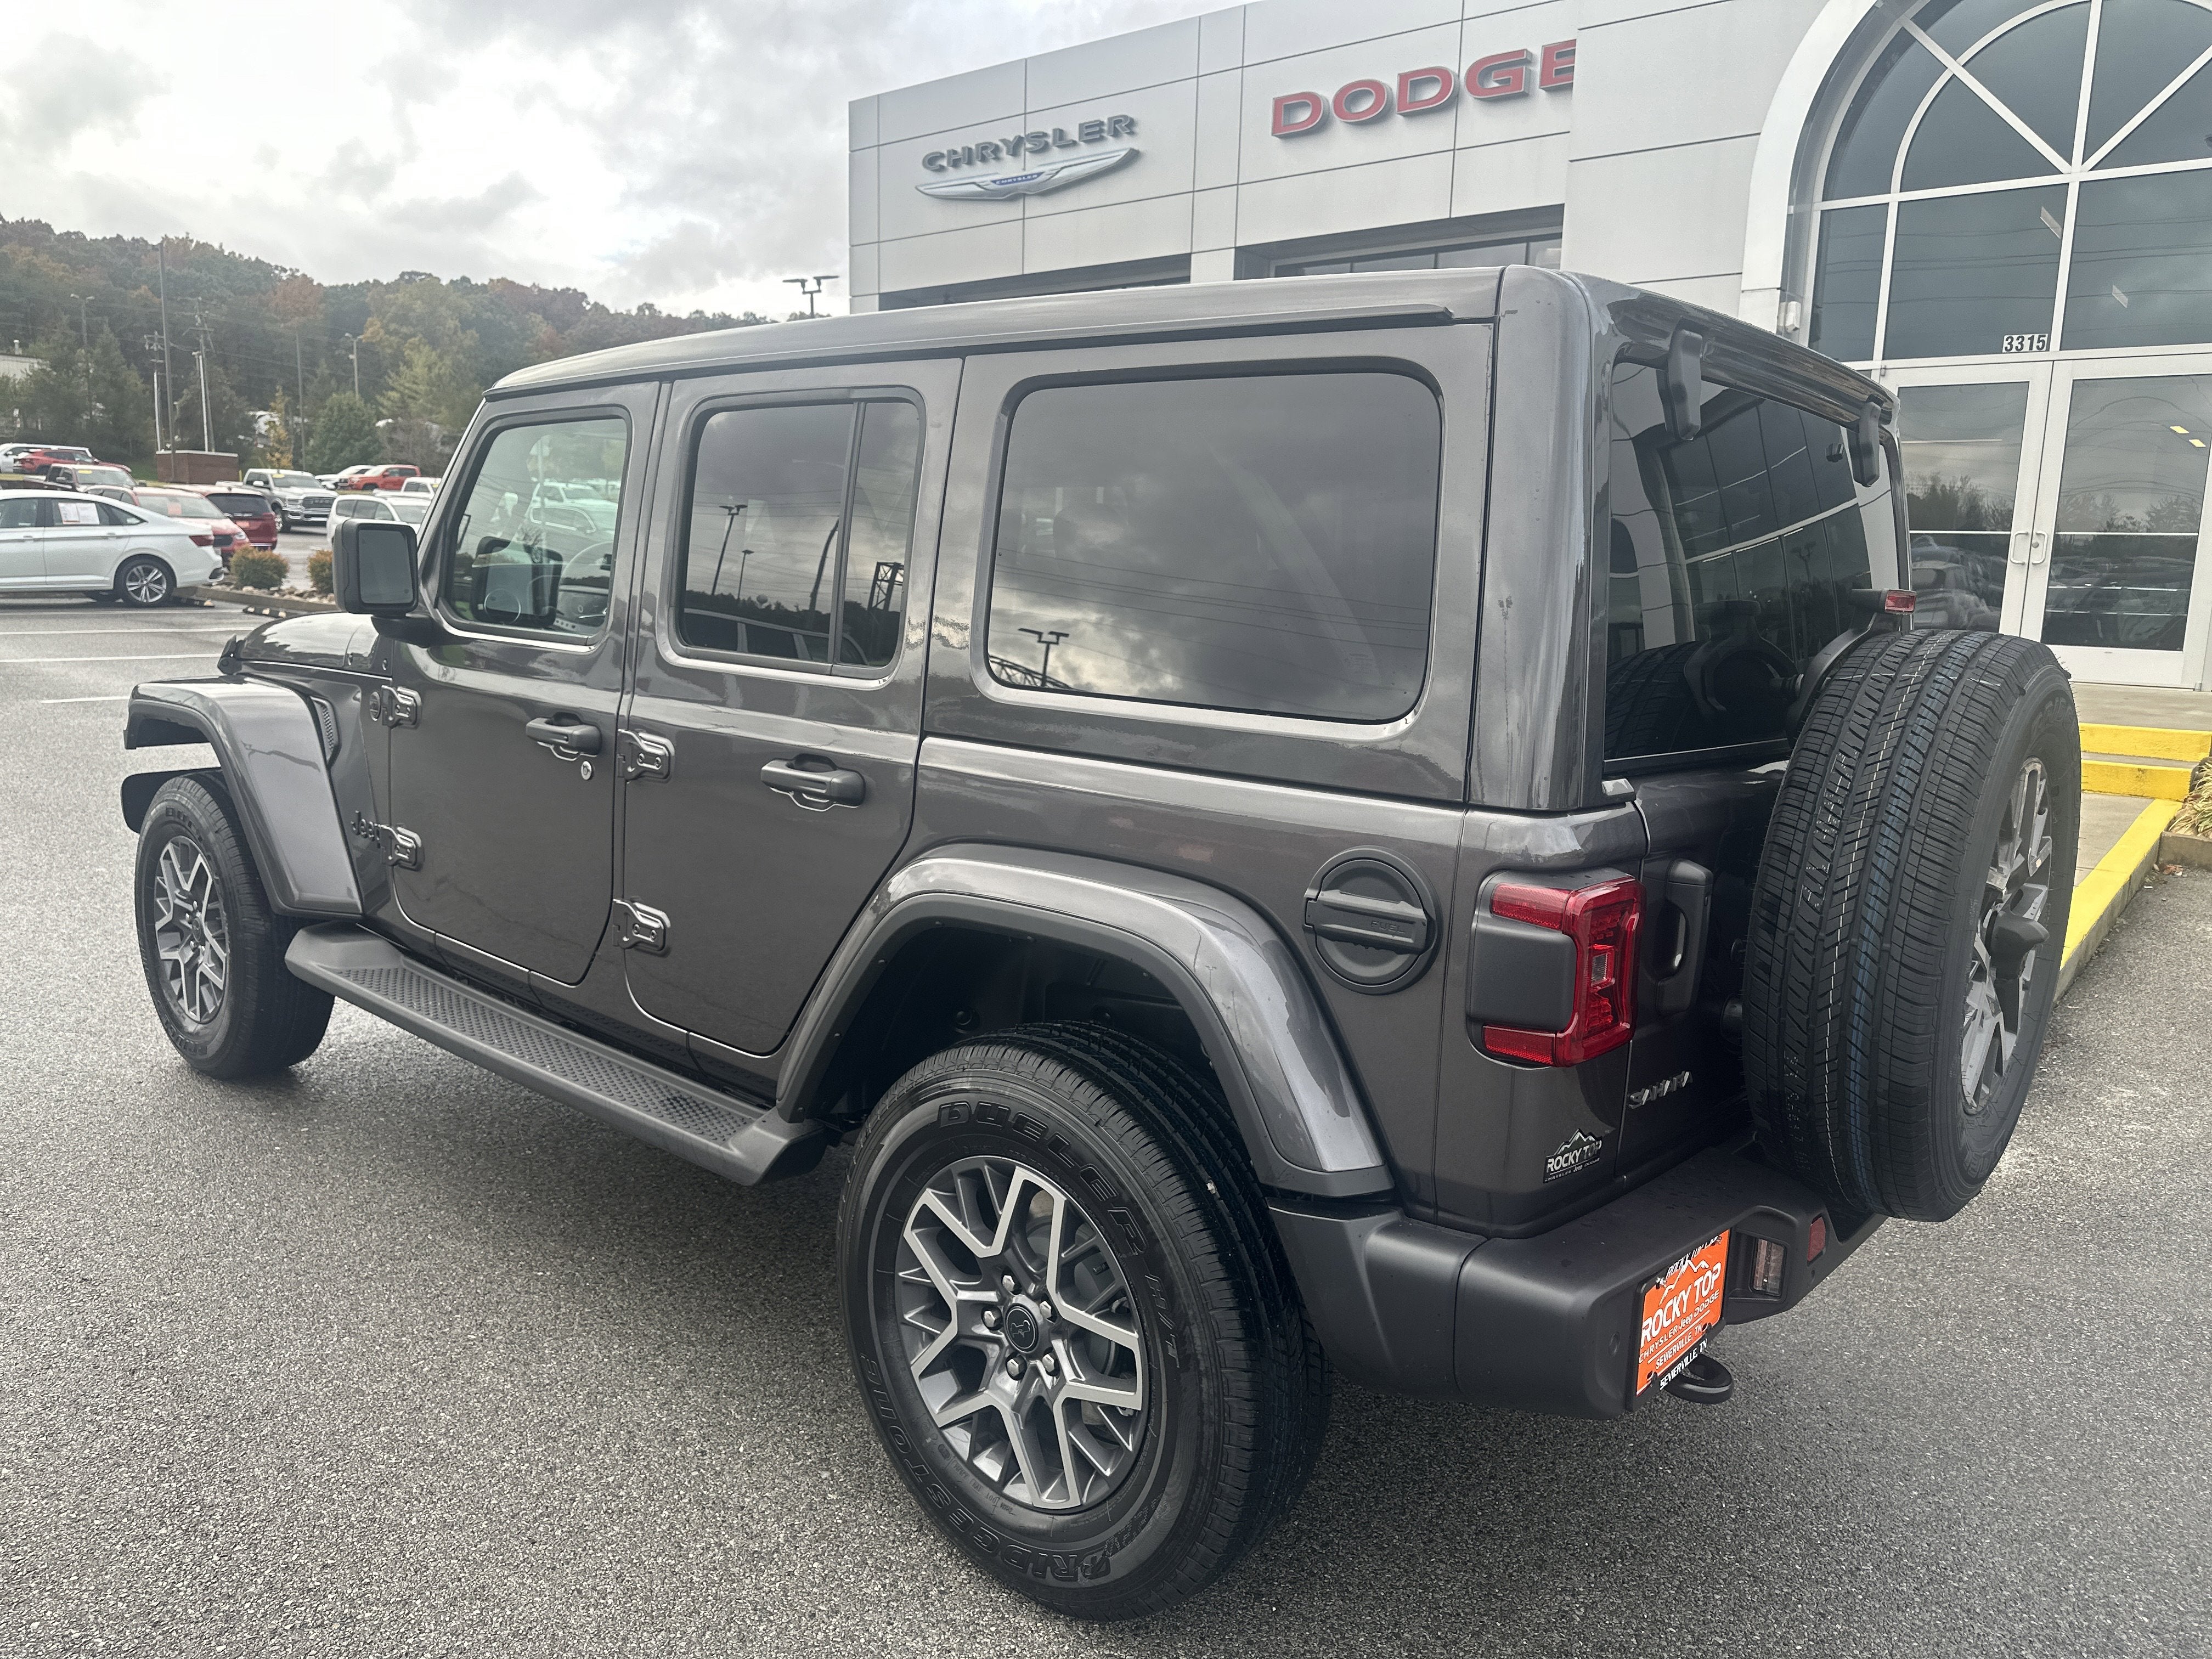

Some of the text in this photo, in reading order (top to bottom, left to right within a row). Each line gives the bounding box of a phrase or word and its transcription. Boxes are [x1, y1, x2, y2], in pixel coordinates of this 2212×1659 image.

[1271, 38, 1576, 136] DODGE
[922, 115, 1134, 171] CHRYSLER
[2004, 335, 2046, 352] 3315
[1370, 921, 1405, 934] FUEL
[938, 1101, 1147, 1259] DUELER
[1547, 1140, 1602, 1173] ROCKY TOP
[1639, 1290, 1719, 1364] CHRYSLER Jeep DODGE
[1640, 1262, 1722, 1350] ROCKY TOP
[1655, 1322, 1702, 1369] SEVIERVILLE, TN
[1660, 1339, 1707, 1390] SEVIERVILLE, TN
[861, 1355, 1111, 1583] BRIDGESTONE
